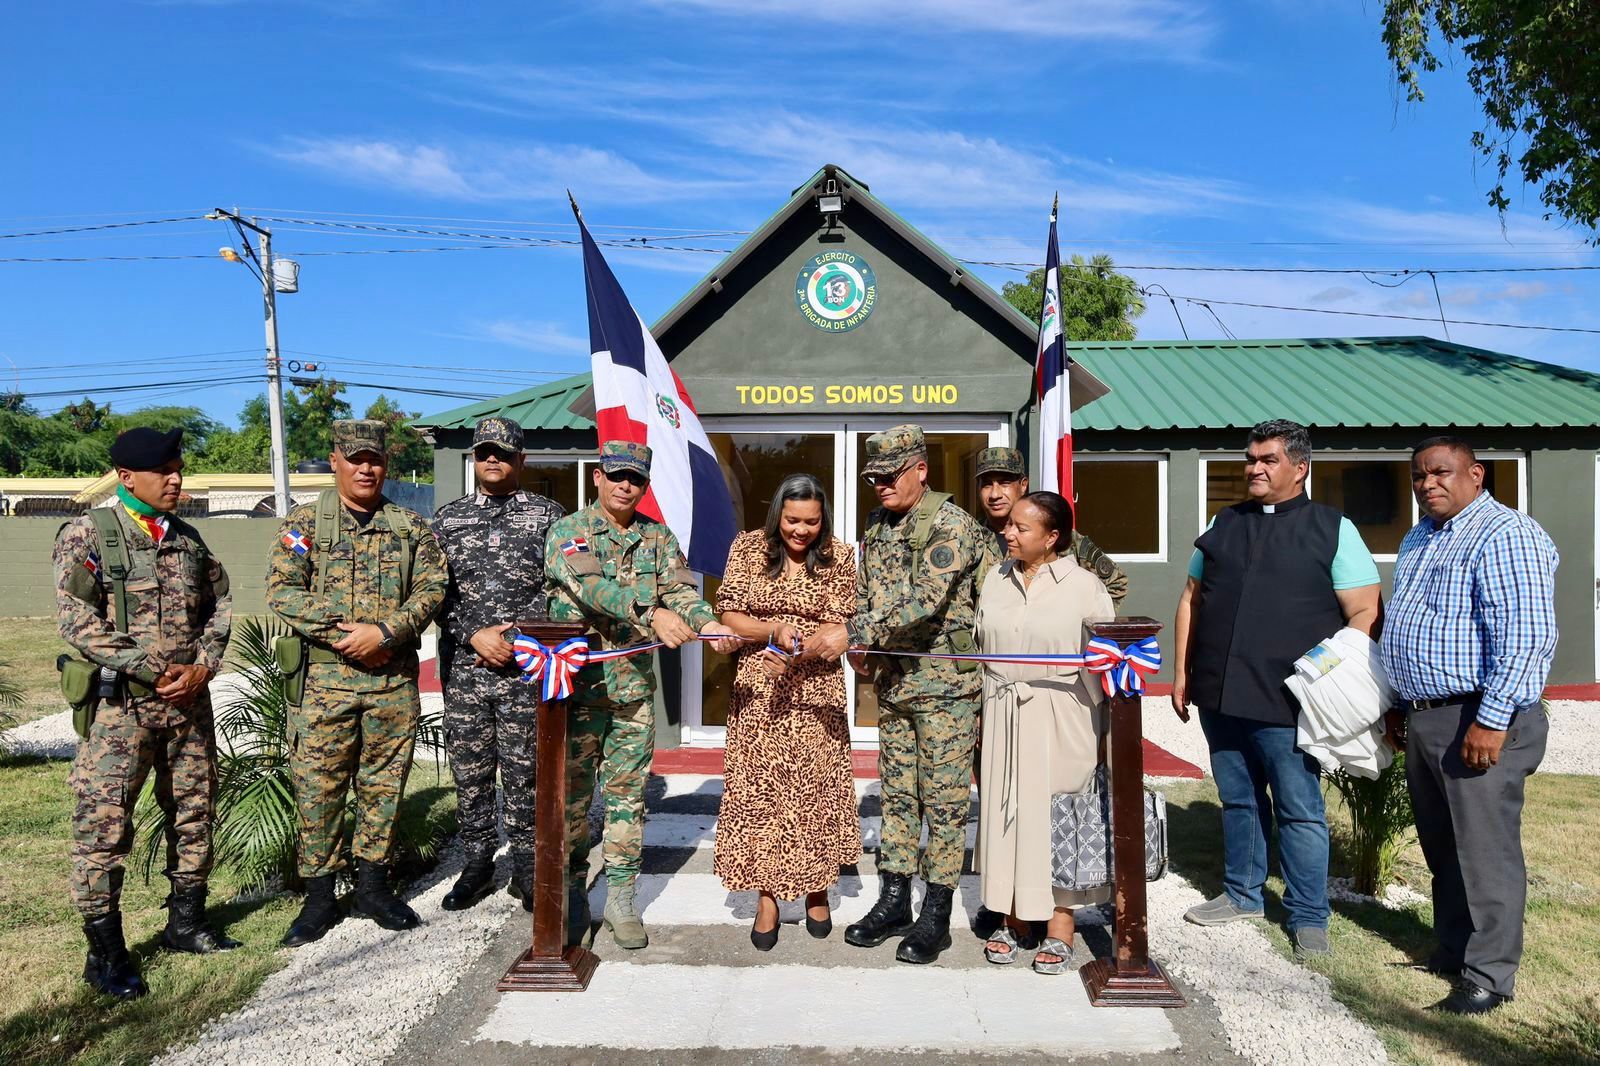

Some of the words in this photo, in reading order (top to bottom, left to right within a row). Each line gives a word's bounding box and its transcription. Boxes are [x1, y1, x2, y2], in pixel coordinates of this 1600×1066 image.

[815, 252, 855, 265] EJERCITO
[822, 281, 846, 297] 13
[800, 303, 832, 329] BRIGADA
[834, 321, 846, 330] DE
[847, 285, 875, 327] INFANTERIA
[735, 385, 815, 404] TODOS
[825, 384, 904, 404] SOMOS
[911, 384, 958, 404] UNO
